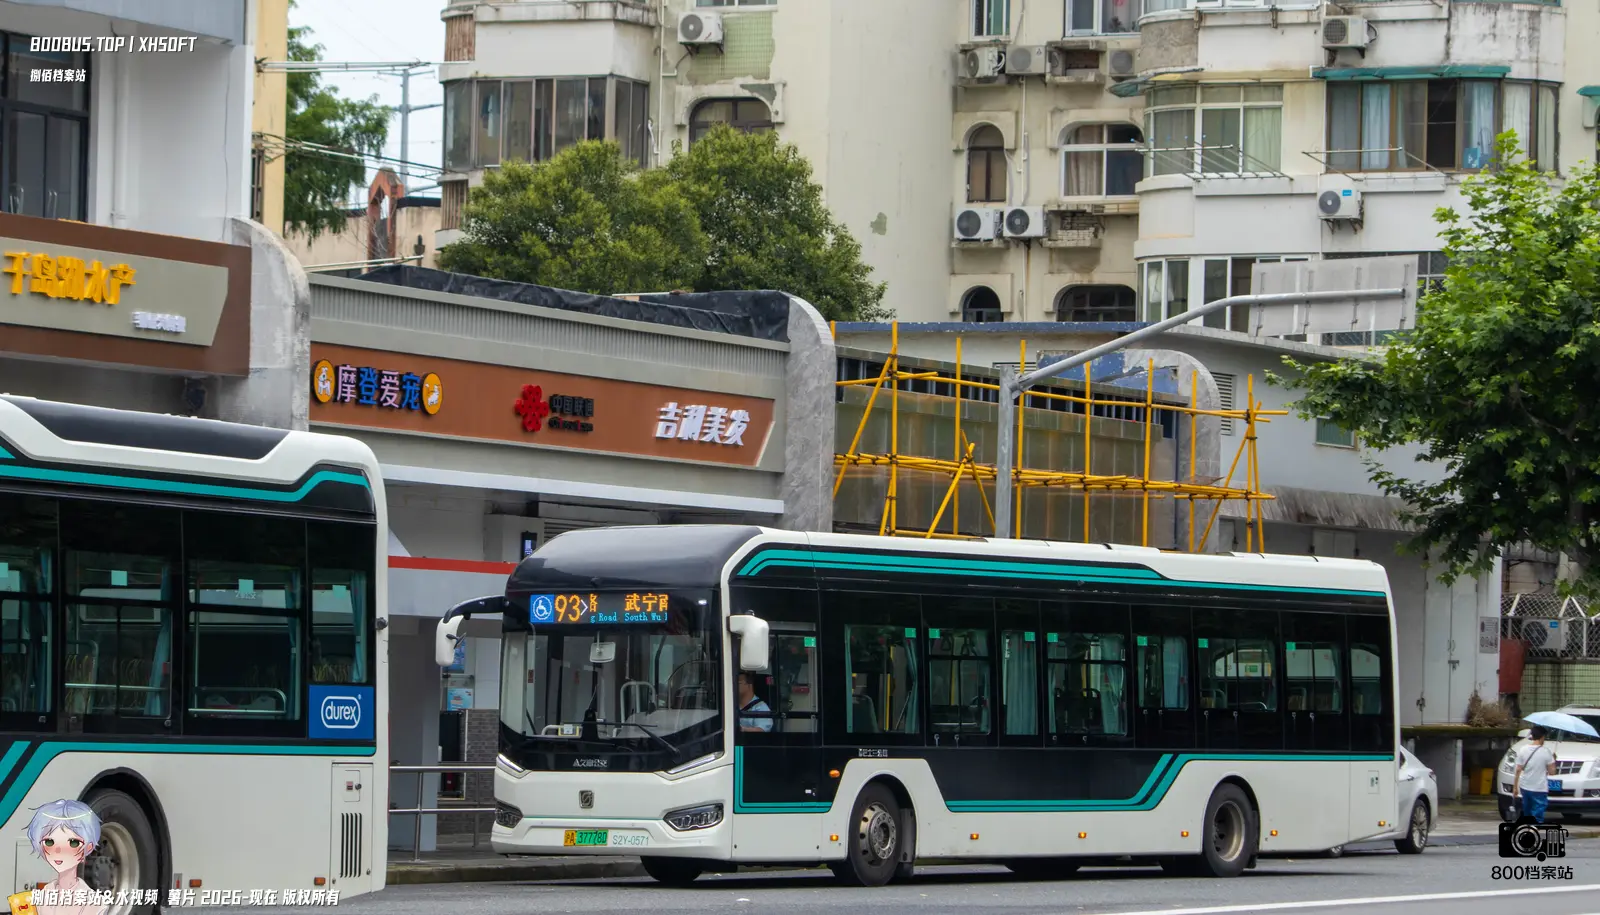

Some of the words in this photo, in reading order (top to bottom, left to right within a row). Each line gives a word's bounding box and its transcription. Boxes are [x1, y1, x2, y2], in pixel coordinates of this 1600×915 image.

[336, 364, 421, 411] 摩登爱宠
[554, 594, 581, 622] 93
[598, 612, 617, 621] Road
[624, 612, 647, 621] South
[651, 612, 660, 621] Wu
[325, 701, 357, 724] durex
[612, 835, 649, 845] S2Y-0571
